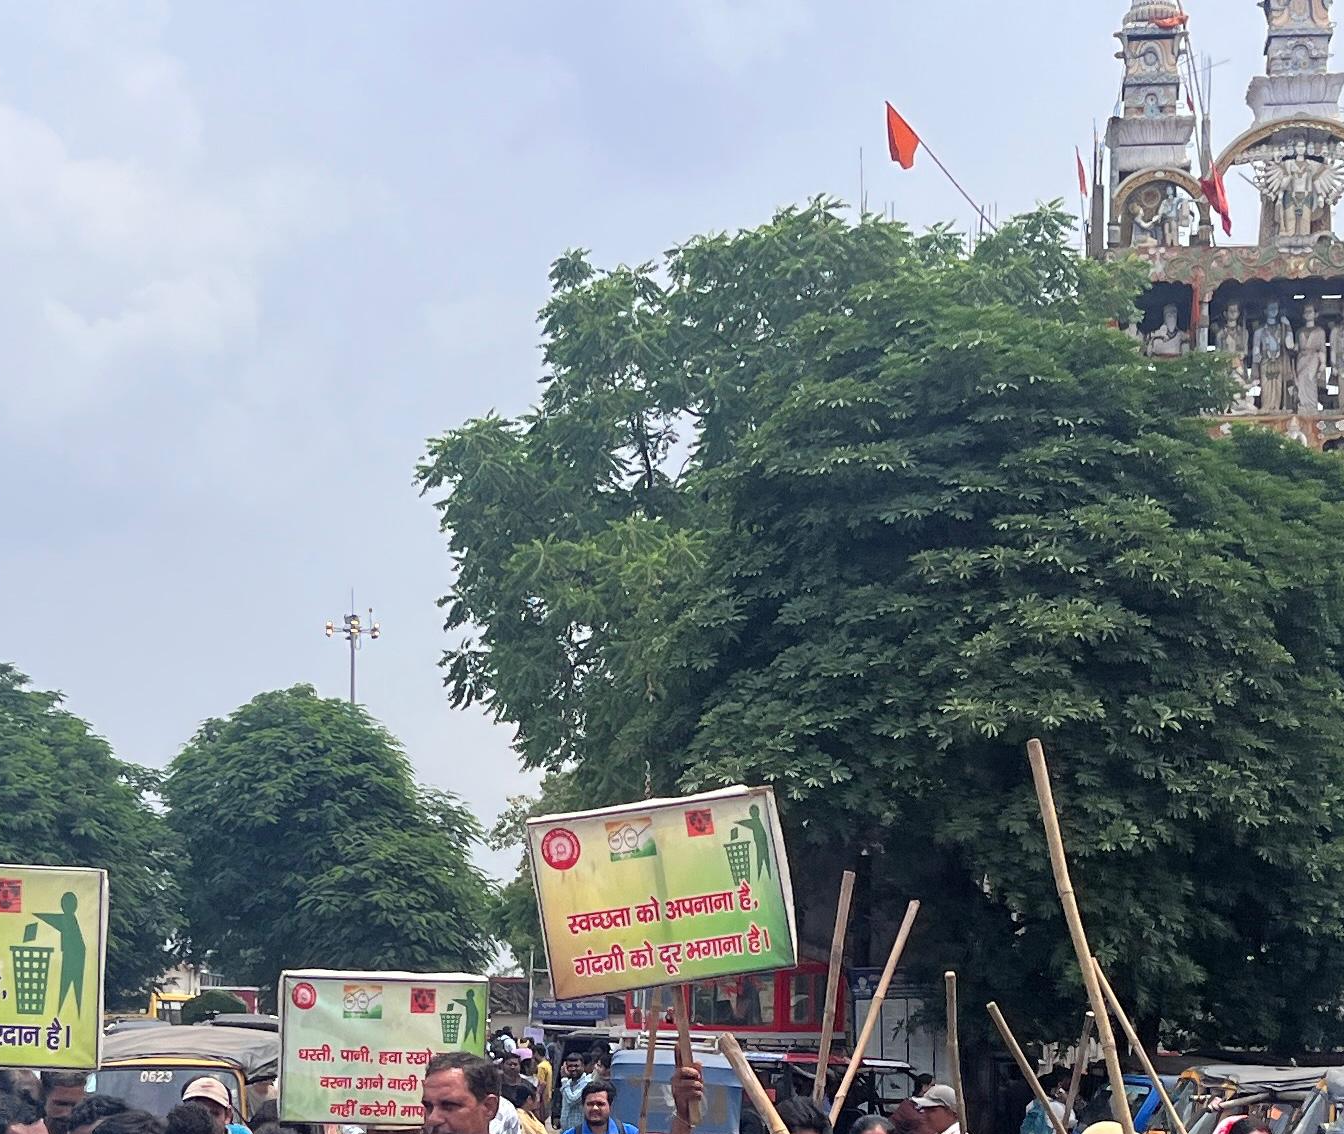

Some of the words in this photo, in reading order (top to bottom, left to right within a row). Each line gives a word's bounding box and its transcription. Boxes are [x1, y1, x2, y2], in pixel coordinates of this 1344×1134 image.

[567, 907, 630, 934] स्वच्छता
[636, 896, 660, 923] को
[665, 891, 733, 920] अपनाना
[737, 881, 759, 911] है,
[574, 945, 624, 976] गंदगी
[629, 941, 654, 967] को
[658, 944, 682, 974] दूर
[686, 934, 742, 960] भगाना
[299, 1045, 334, 1062] धरती,
[341, 1046, 373, 1063] पानी,
[379, 1051, 402, 1064] हवा
[140, 1071, 174, 1083] 0623
[320, 1076, 352, 1089] वरना
[356, 1074, 383, 1090] आने
[387, 1074, 418, 1091] वाली
[330, 1099, 357, 1117] नहीं
[360, 1100, 396, 1117] करेगी
